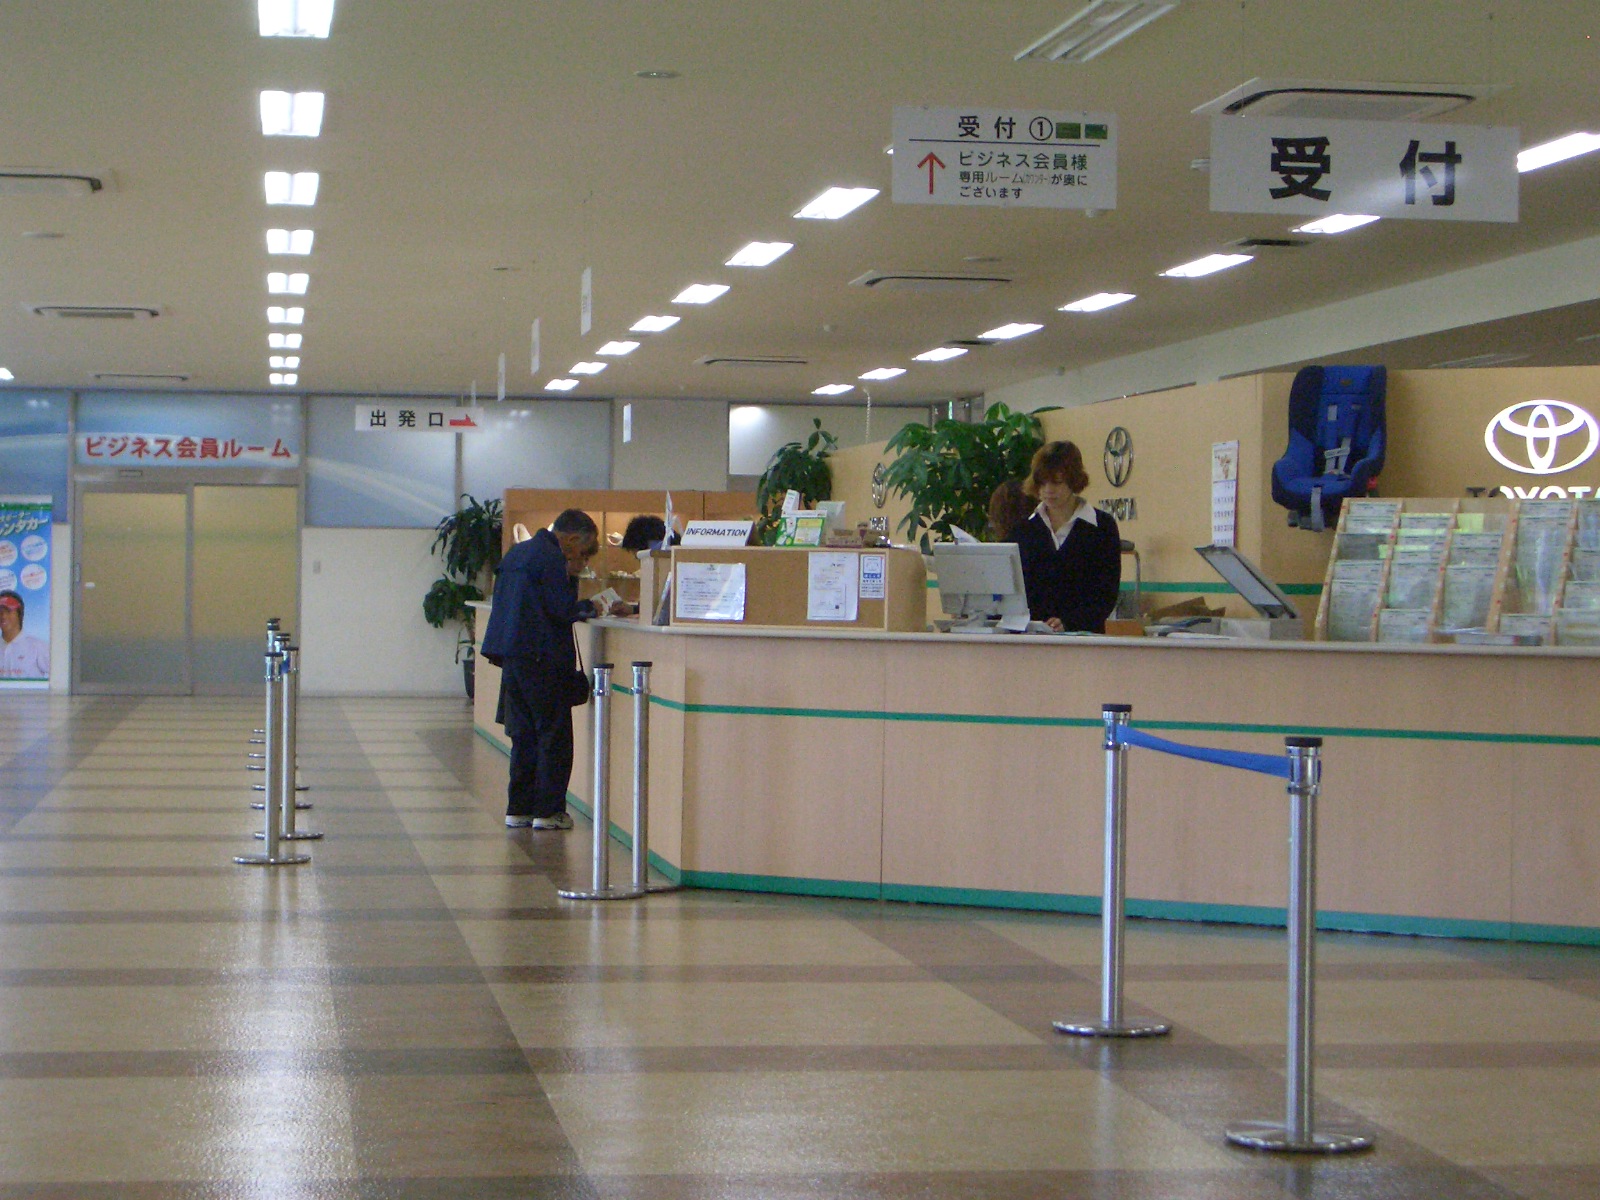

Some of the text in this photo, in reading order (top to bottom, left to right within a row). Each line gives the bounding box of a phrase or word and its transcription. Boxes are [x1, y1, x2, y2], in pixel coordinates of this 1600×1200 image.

[959, 151, 1088, 171] ビジネス会員様
[1269, 136, 1463, 206] 受付
[959, 186, 1023, 198] ございます
[369, 409, 444, 428] 出発口
[85, 436, 292, 459] ビジネス会員ルーム
[685, 527, 748, 537] INFORMATION
